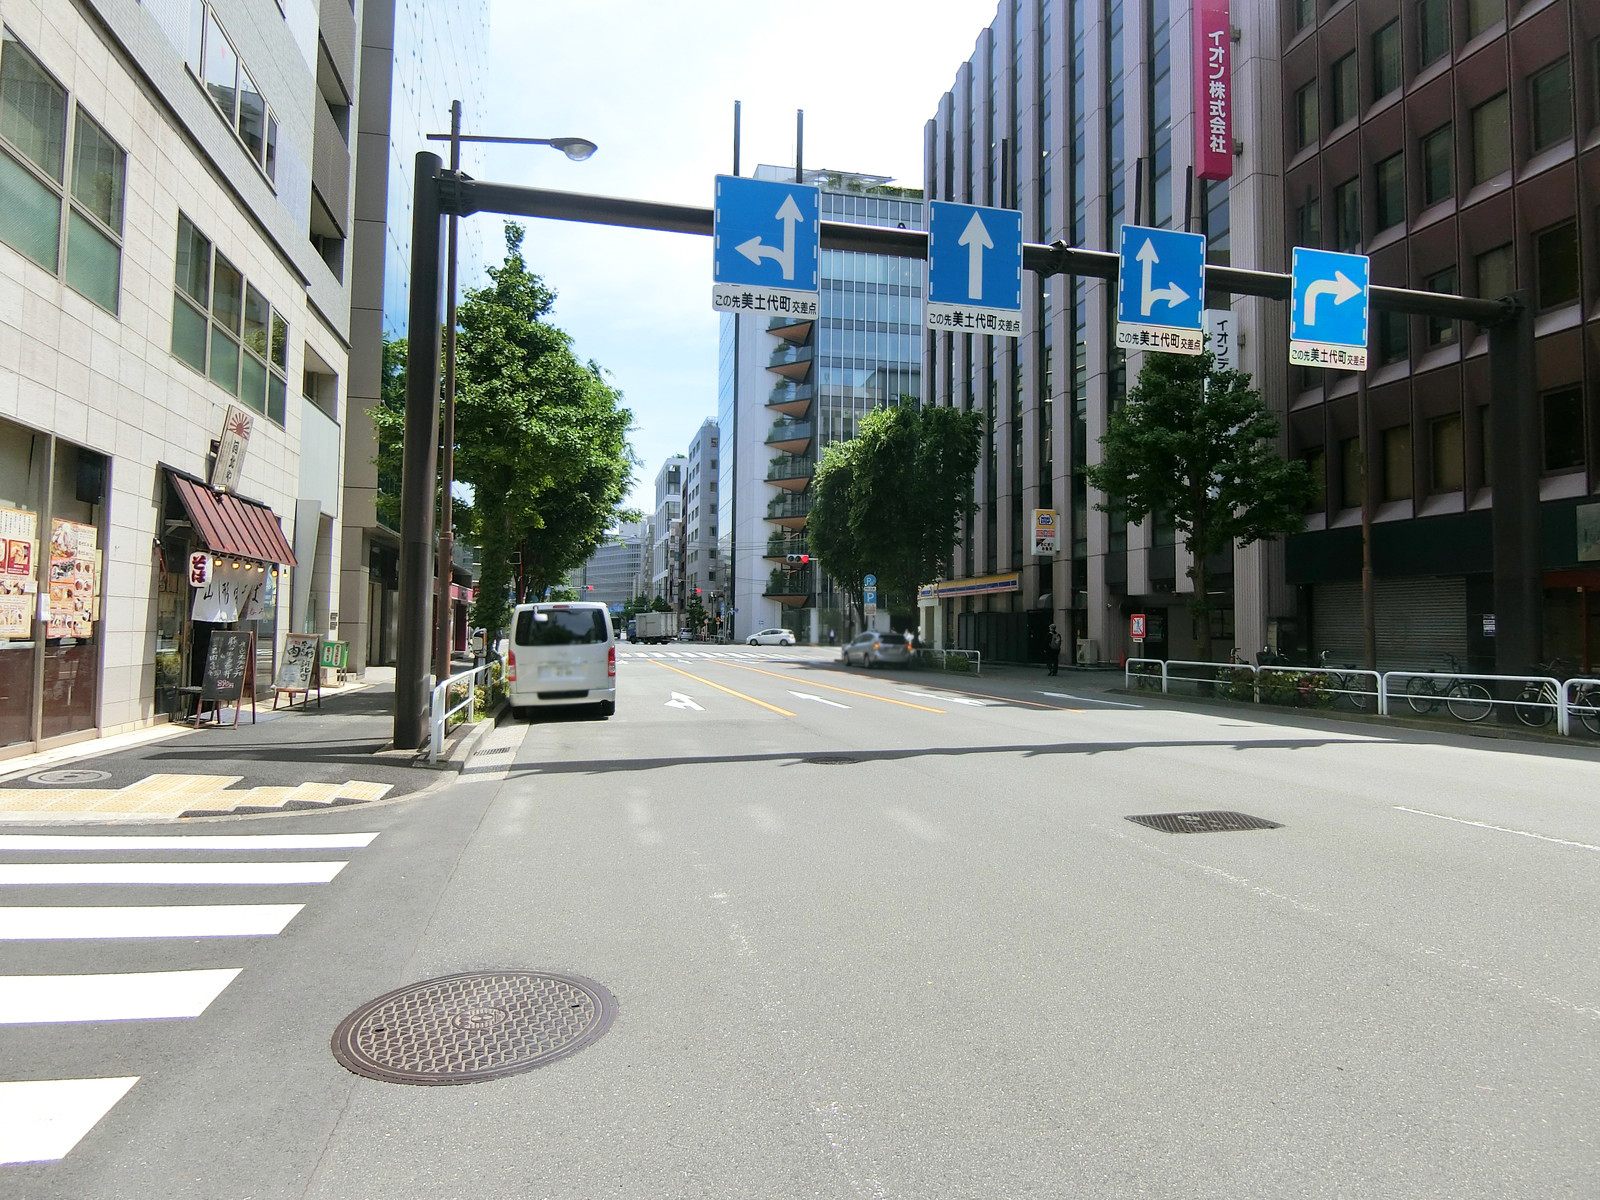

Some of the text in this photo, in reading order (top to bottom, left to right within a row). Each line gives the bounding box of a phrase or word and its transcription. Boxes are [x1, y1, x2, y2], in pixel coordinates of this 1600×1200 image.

[1208, 30, 1226, 153] イオン株式会社
[715, 292, 817, 315] この先美土代町交差点
[929, 311, 1020, 332] この先美土代町交差点
[1119, 330, 1201, 350] この先美土代町交差点
[1291, 347, 1365, 366] この先美土代町交差点
[192, 555, 207, 583] そば
